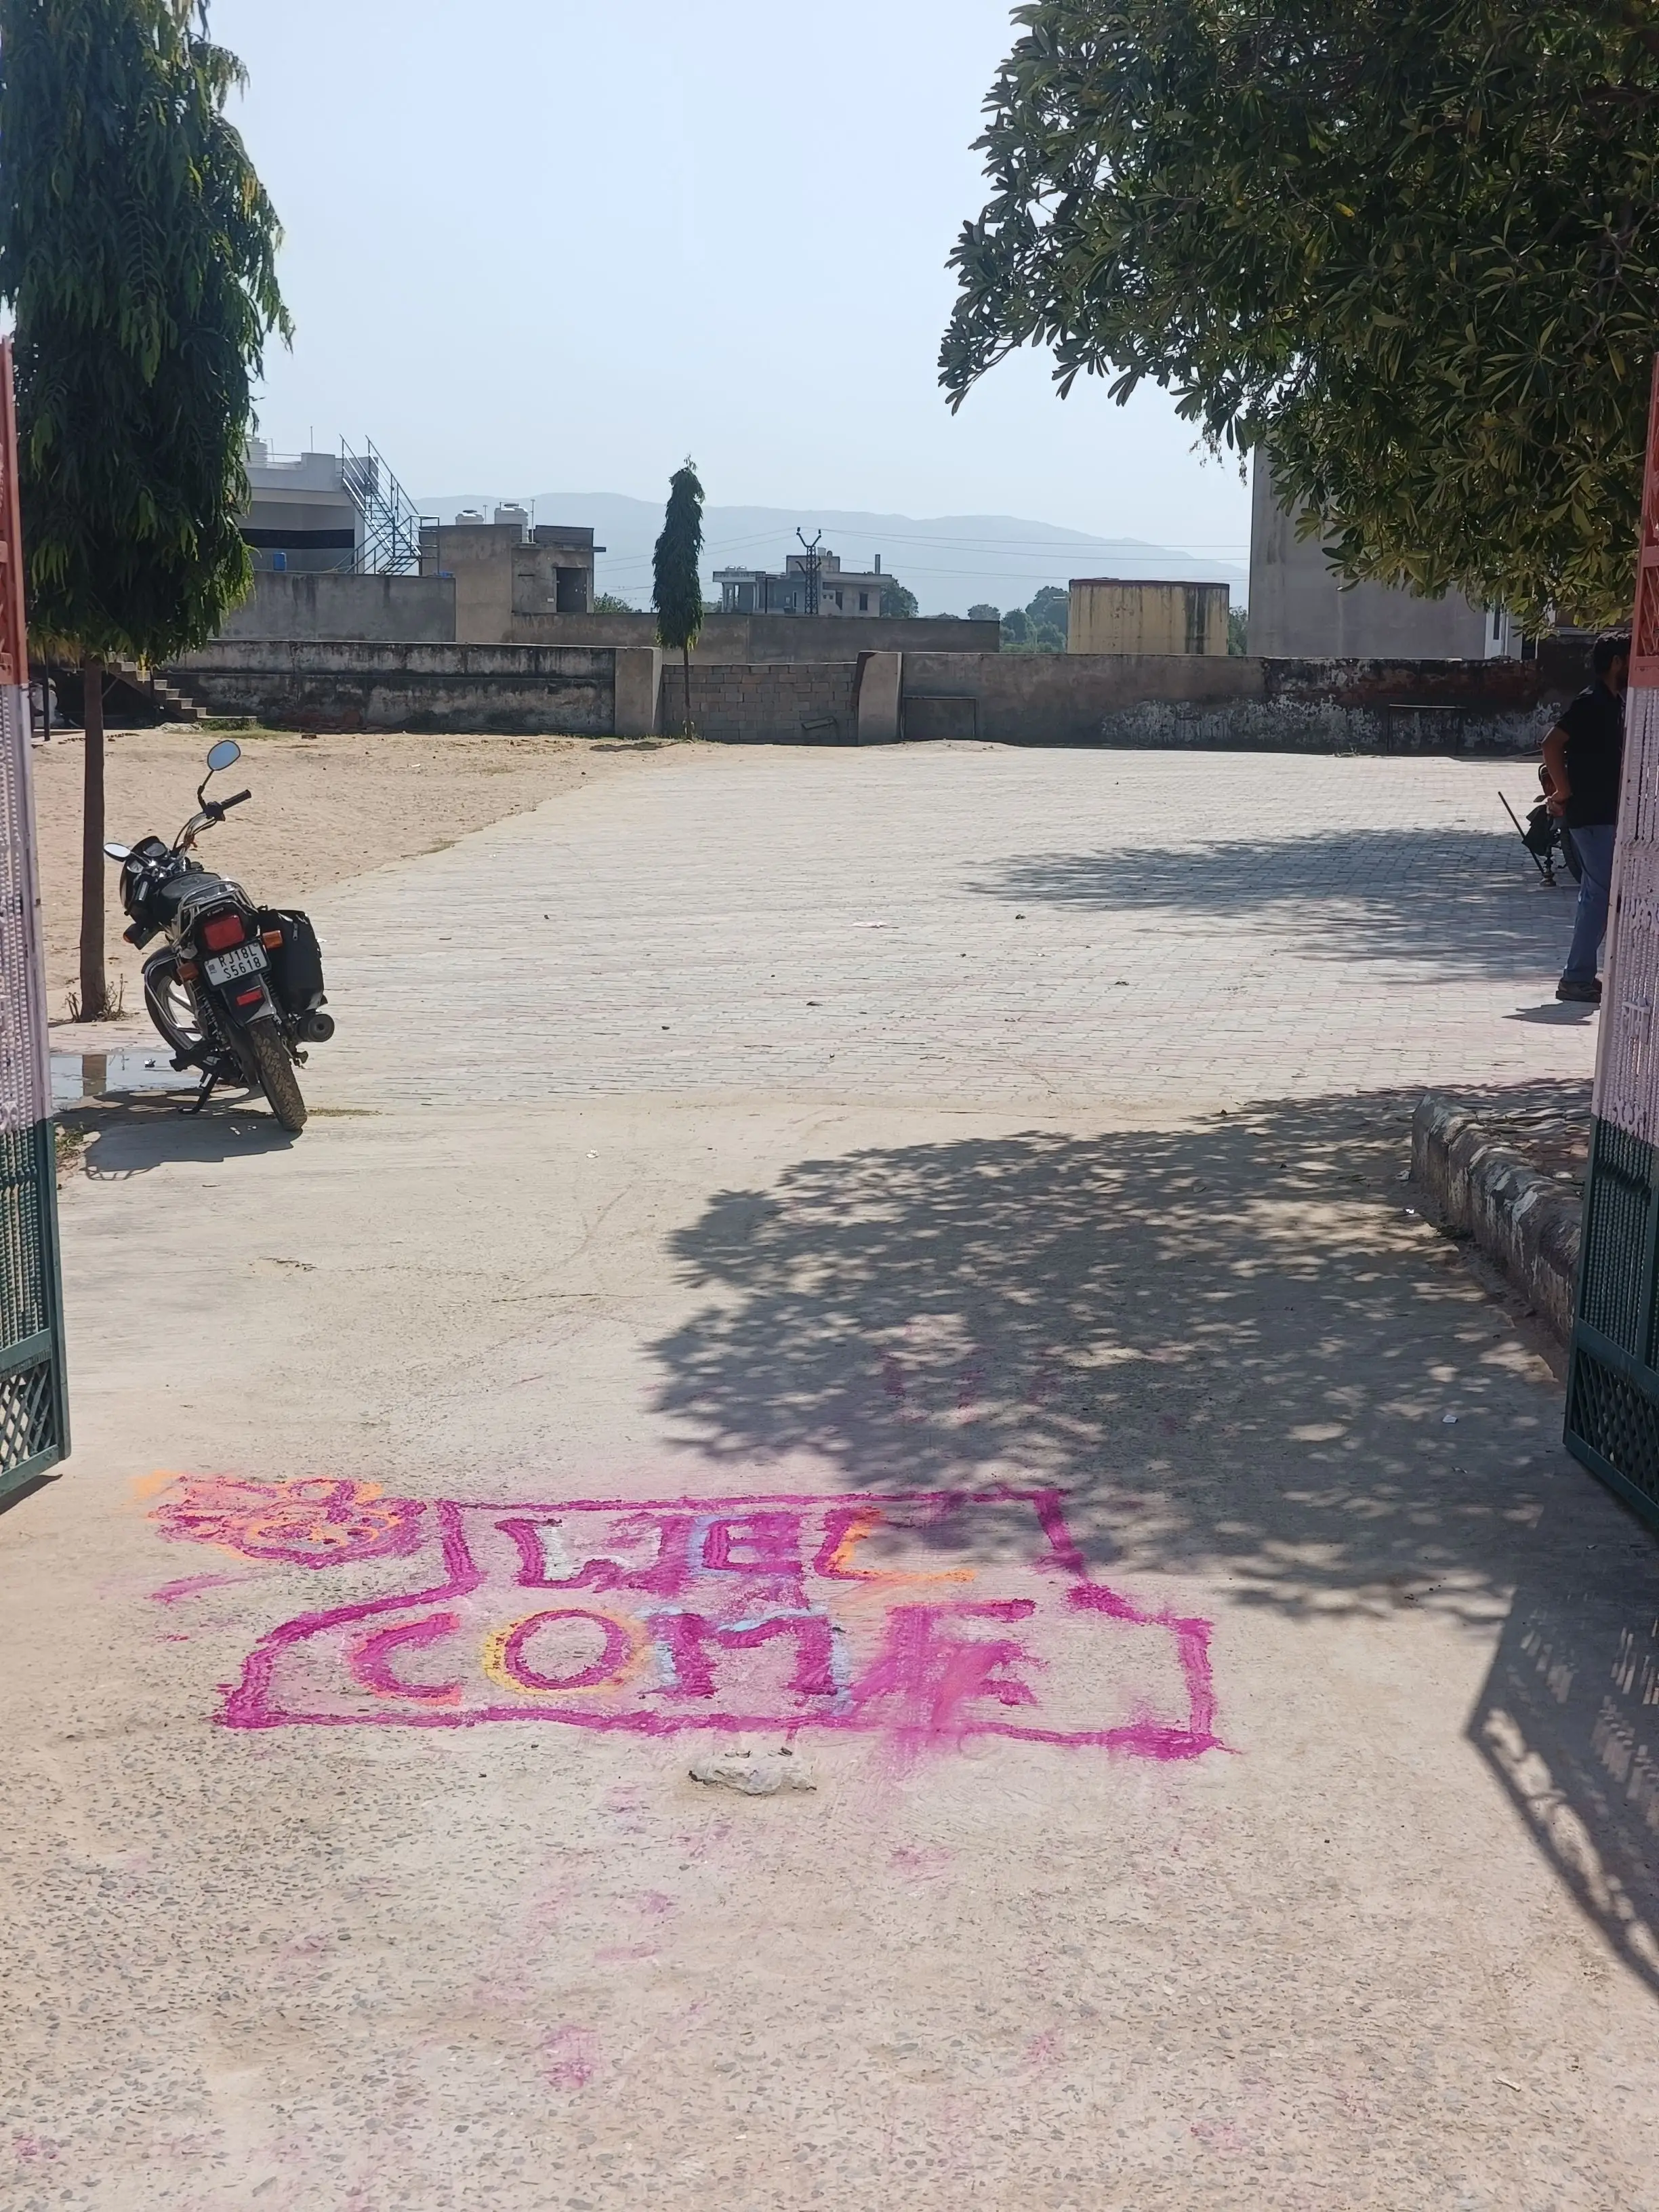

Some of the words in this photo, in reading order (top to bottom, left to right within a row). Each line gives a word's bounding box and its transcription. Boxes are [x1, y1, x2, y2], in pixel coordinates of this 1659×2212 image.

[219, 945, 257, 967] RJ18L
[224, 958, 261, 979] S5618
[495, 1507, 973, 1595] WEL
[351, 1598, 1038, 1713] COME
